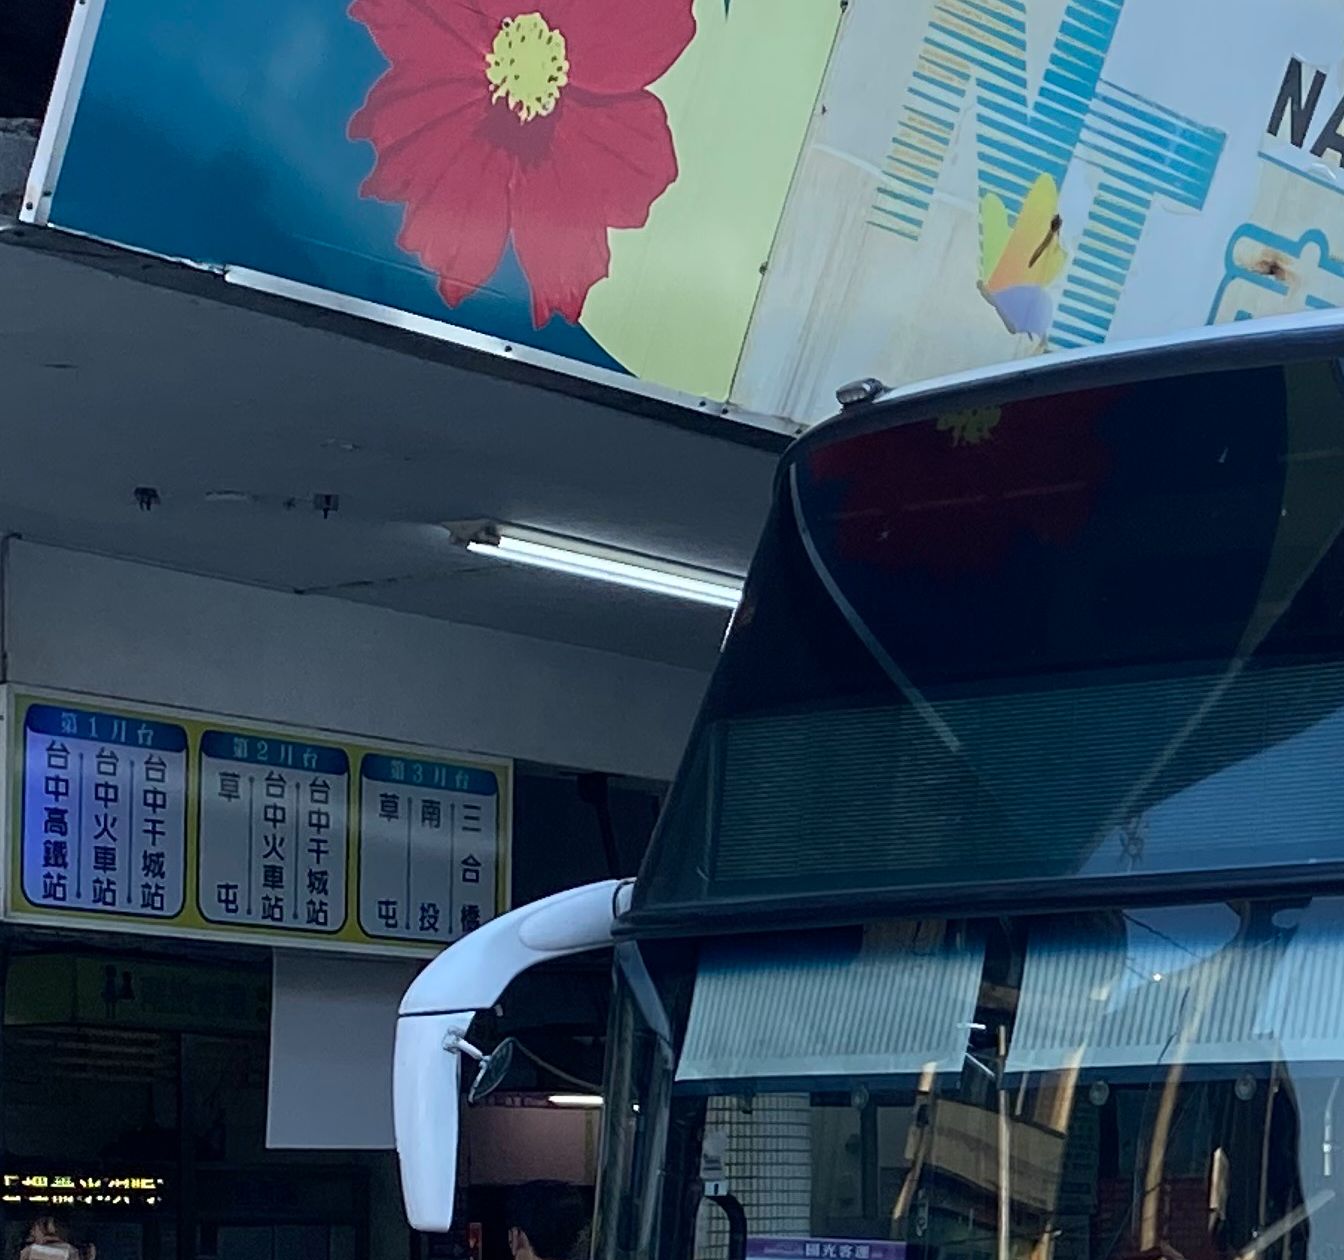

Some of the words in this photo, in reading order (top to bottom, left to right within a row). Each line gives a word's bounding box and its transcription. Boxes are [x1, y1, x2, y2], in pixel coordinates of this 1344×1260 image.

[60, 711, 154, 746] 第1月台
[232, 736, 319, 771] 第2月台
[389, 759, 470, 791] 第3月台
[41, 739, 71, 902] 台中高鐵站
[91, 746, 120, 908] 台中火車站
[140, 753, 168, 912] 台中干城站
[216, 771, 241, 915] 草屯
[260, 769, 287, 923] 台中火車站
[305, 776, 332, 927] 台中干城站
[377, 792, 400, 930] 草屯
[417, 799, 441, 934] 南投
